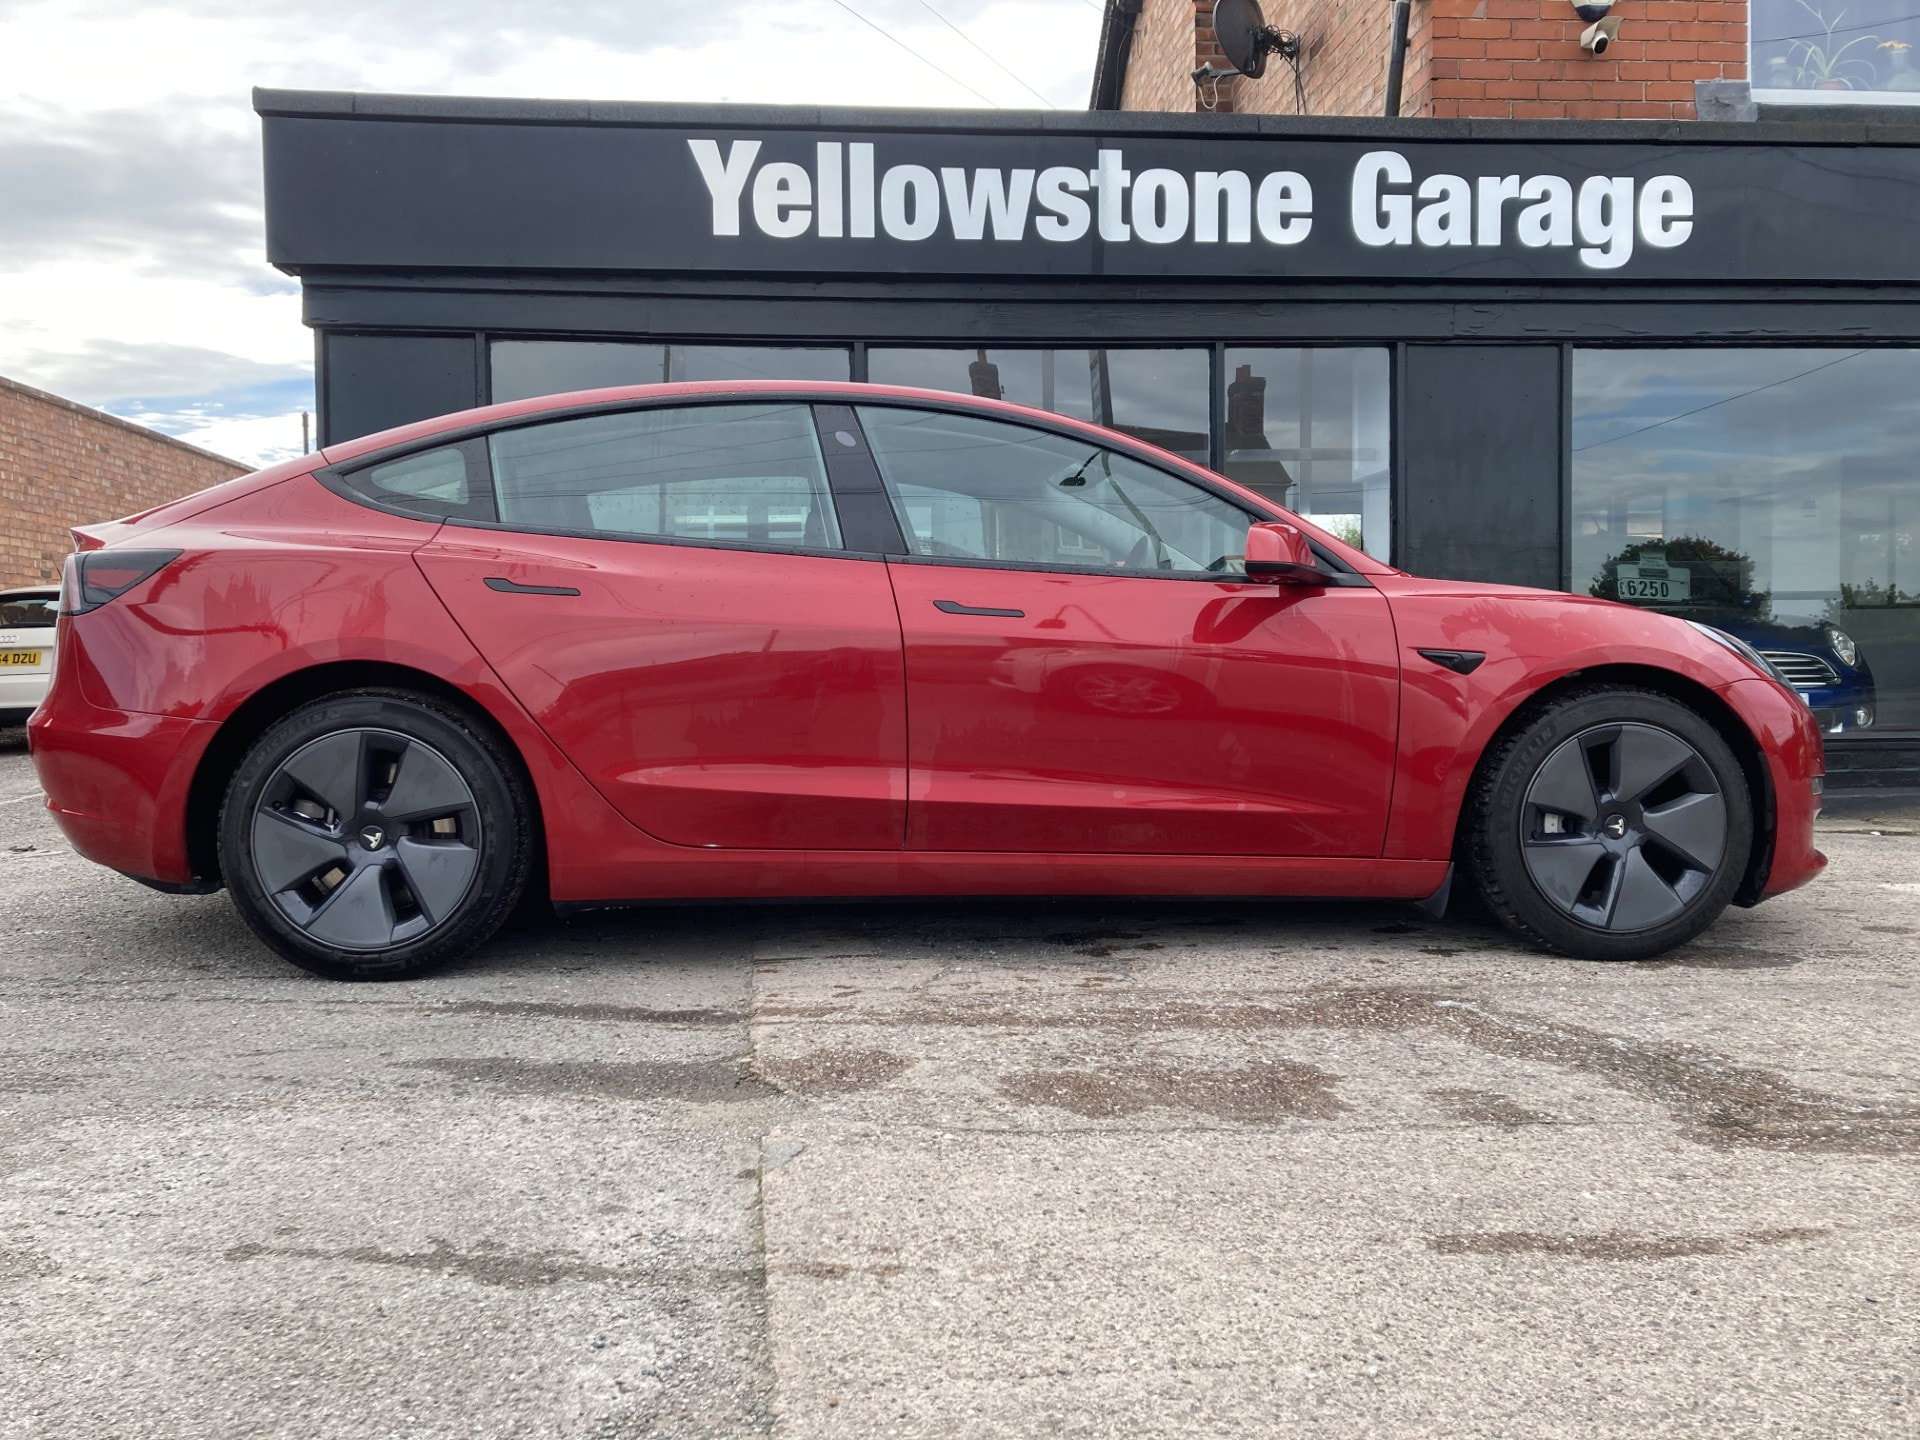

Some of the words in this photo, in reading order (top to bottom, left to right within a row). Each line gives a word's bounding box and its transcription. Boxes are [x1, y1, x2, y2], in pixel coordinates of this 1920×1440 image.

[687, 140, 1313, 245] Yellowstone
[1352, 151, 1694, 270] Garage
[1619, 580, 1669, 598] £6250
[12, 652, 37, 664] DZU
